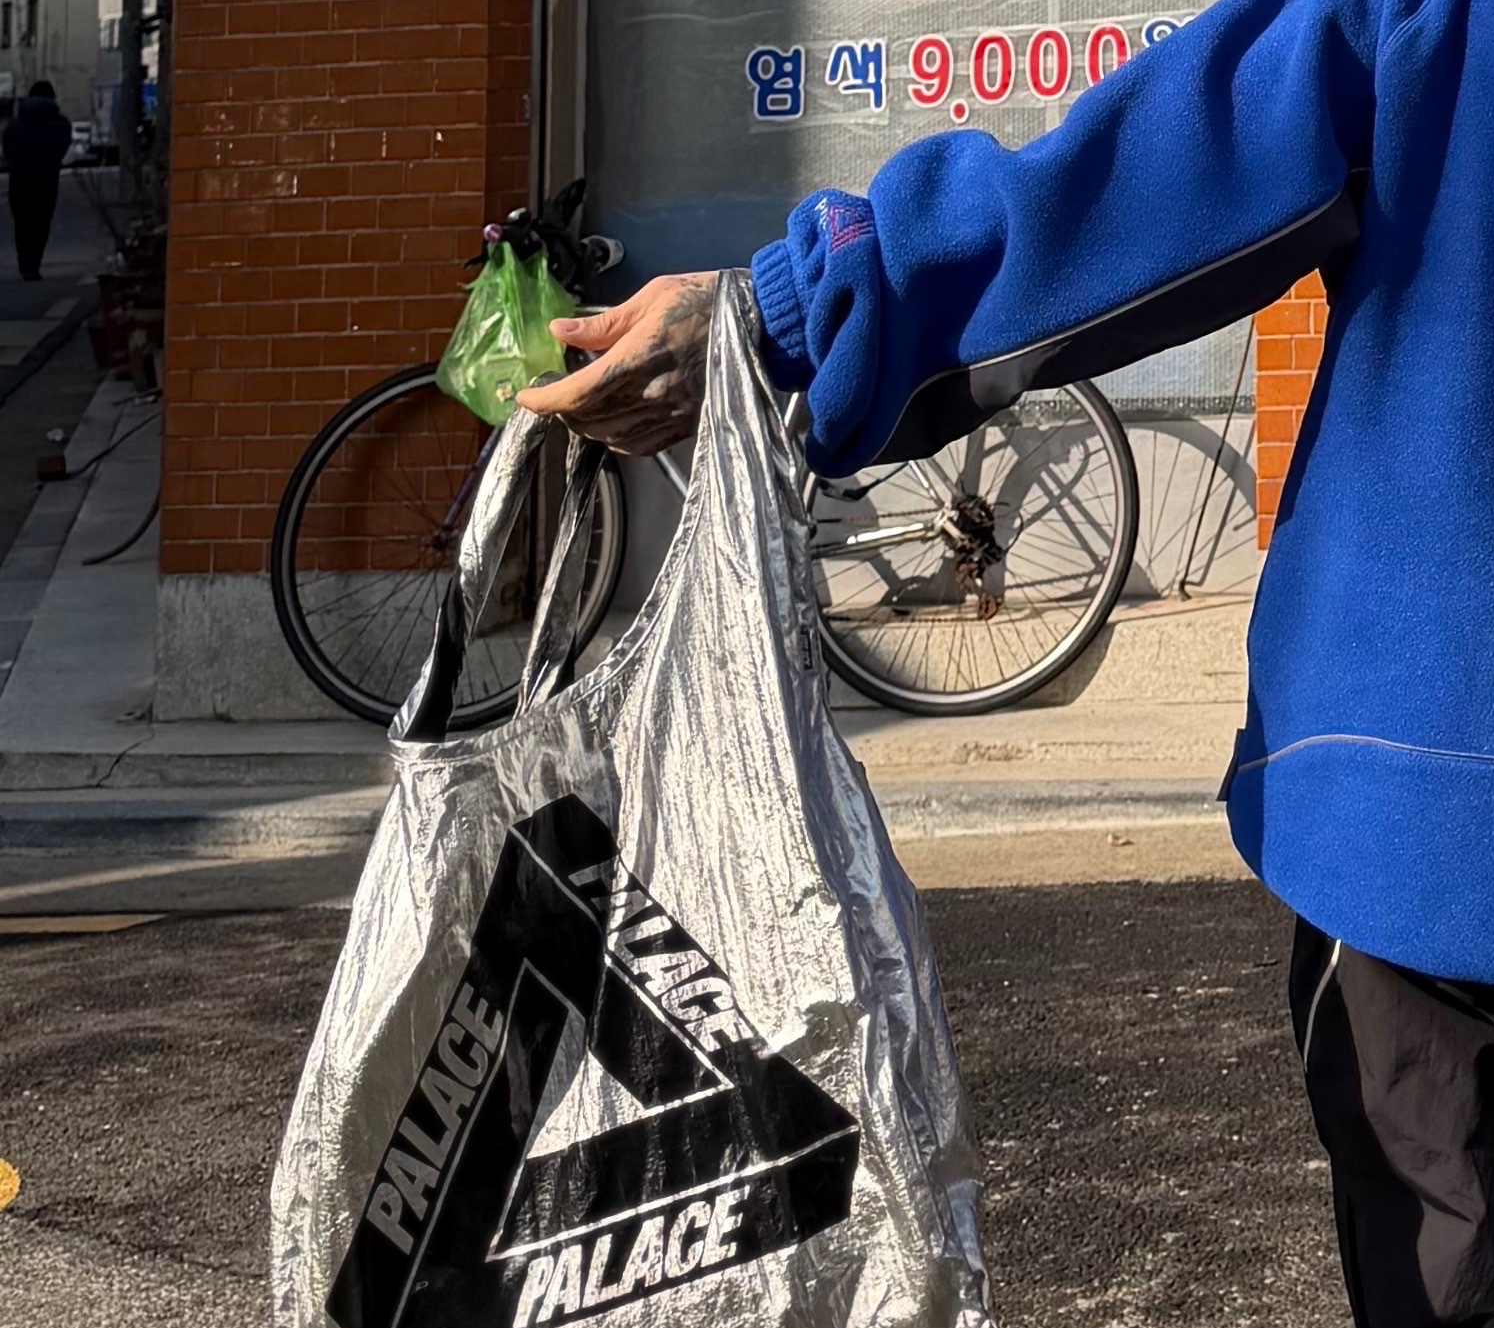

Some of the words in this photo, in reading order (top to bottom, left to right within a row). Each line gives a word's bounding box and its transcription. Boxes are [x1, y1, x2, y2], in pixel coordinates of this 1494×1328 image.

[745, 37, 889, 122] 염색
[908, 16, 1199, 124] 9.000
[567, 855, 755, 1053] PALACE
[365, 981, 506, 1255] PALACE
